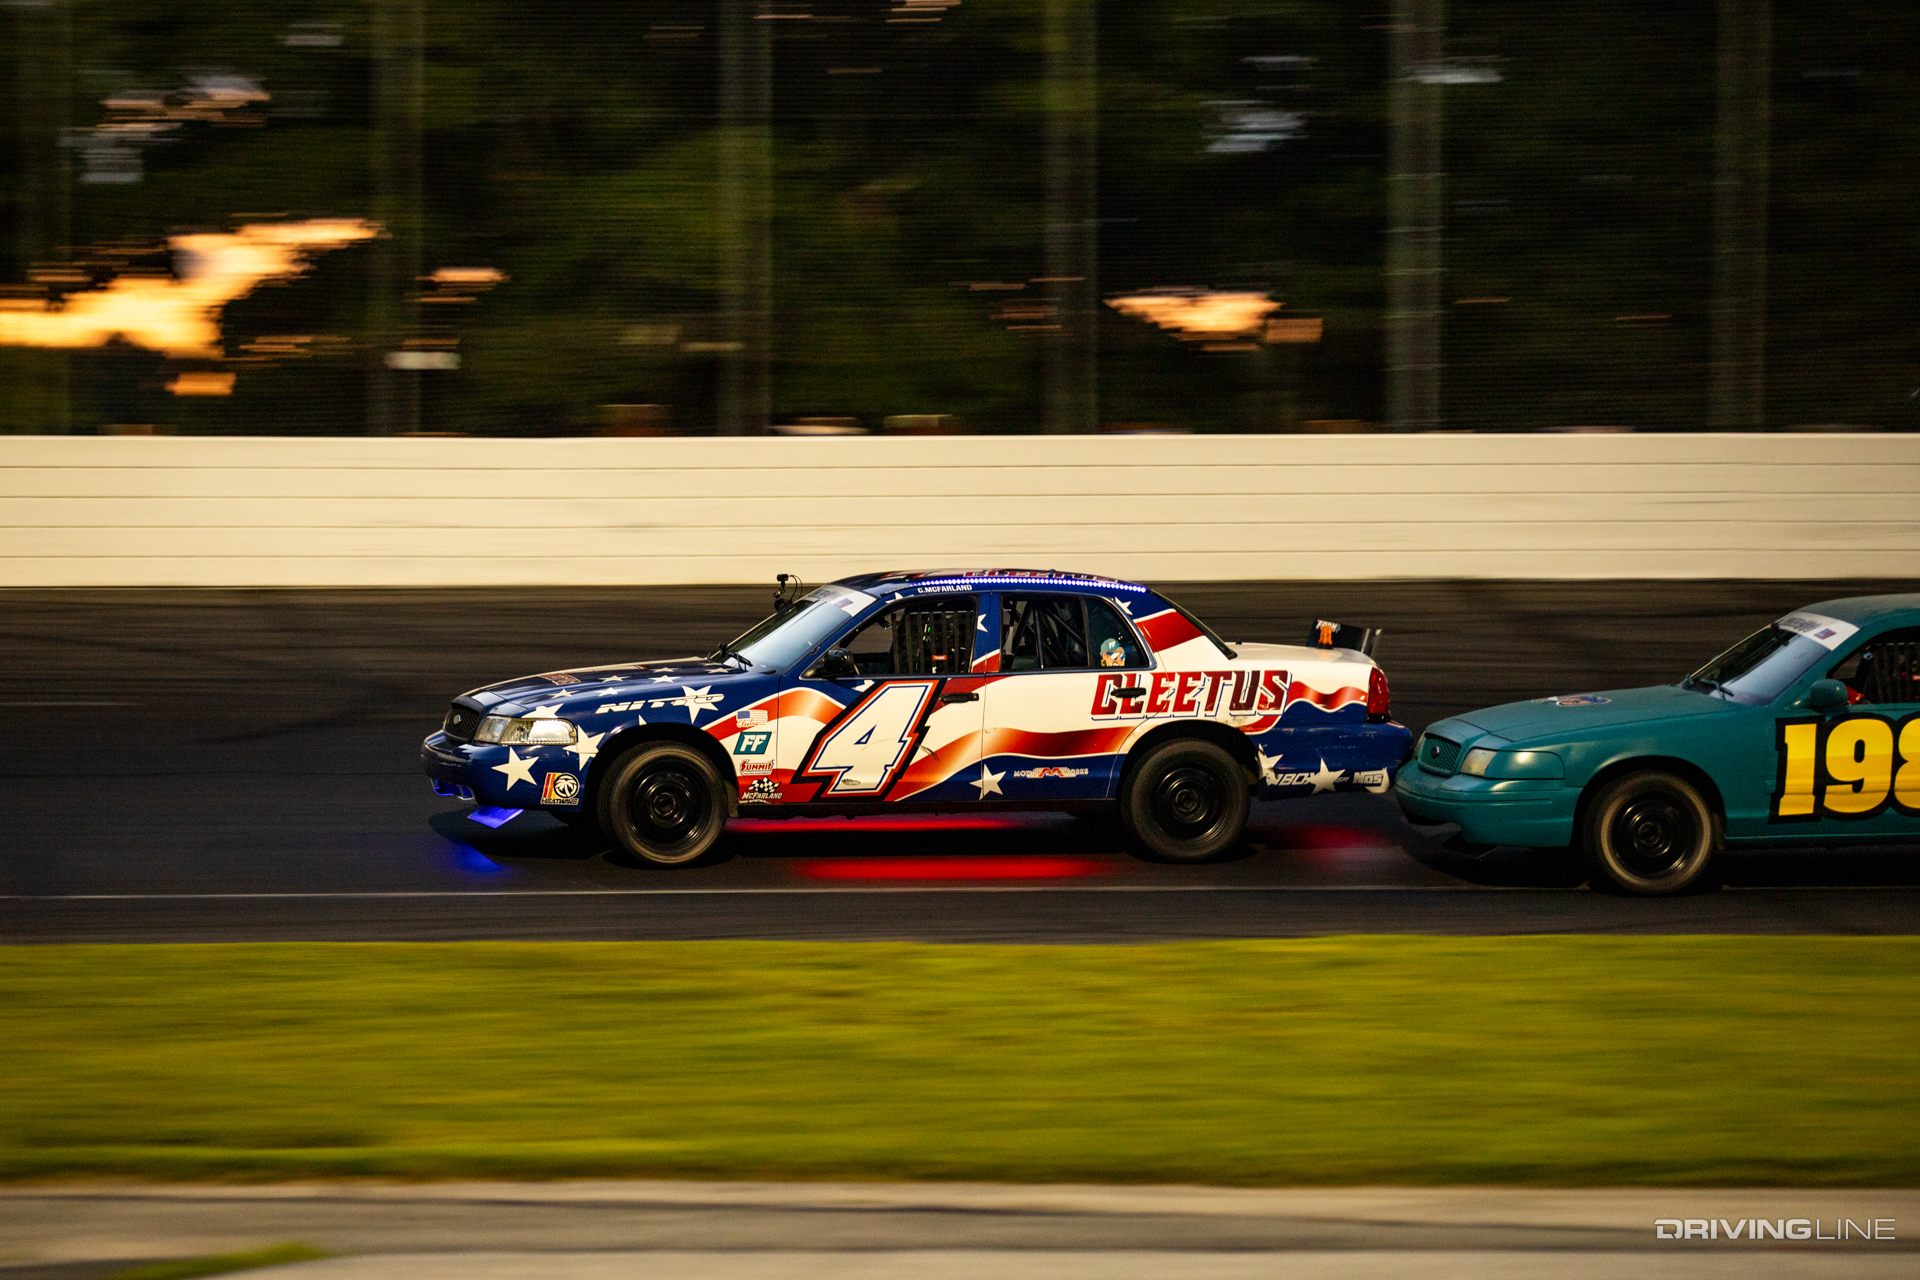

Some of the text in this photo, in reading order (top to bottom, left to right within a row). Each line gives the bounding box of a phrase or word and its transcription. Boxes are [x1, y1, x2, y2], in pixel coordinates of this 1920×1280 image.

[917, 584, 973, 594] C.MCFARLAND
[1090, 669, 1292, 721] CLEETUS
[739, 734, 768, 752] FF
[807, 682, 934, 796] 4
[1352, 771, 1384, 784] NOS
